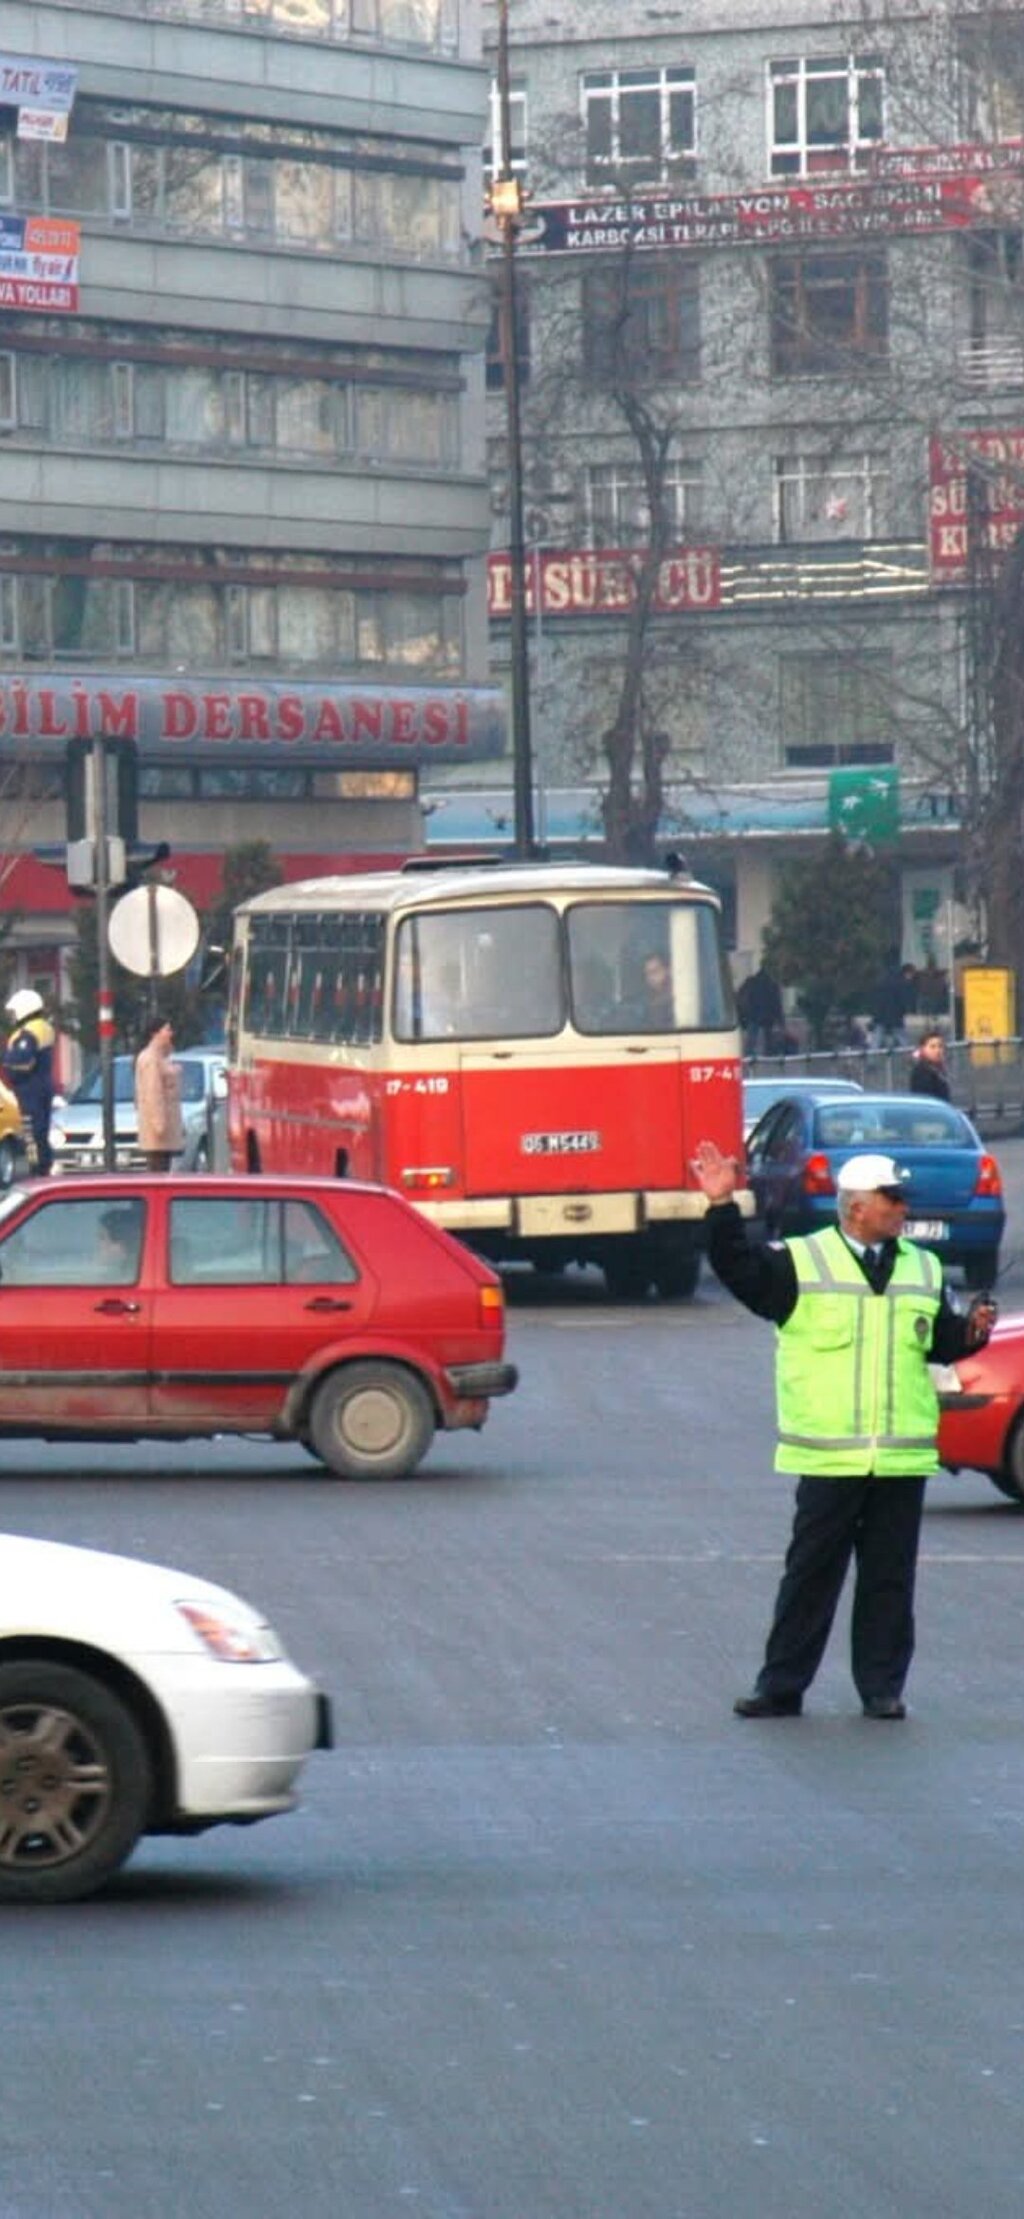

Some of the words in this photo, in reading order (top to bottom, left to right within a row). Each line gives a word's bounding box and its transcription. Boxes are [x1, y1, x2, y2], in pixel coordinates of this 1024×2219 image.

[569, 205, 646, 224] LAZER
[0, 679, 137, 738] İLİM
[161, 689, 469, 745] DERSANESİ
